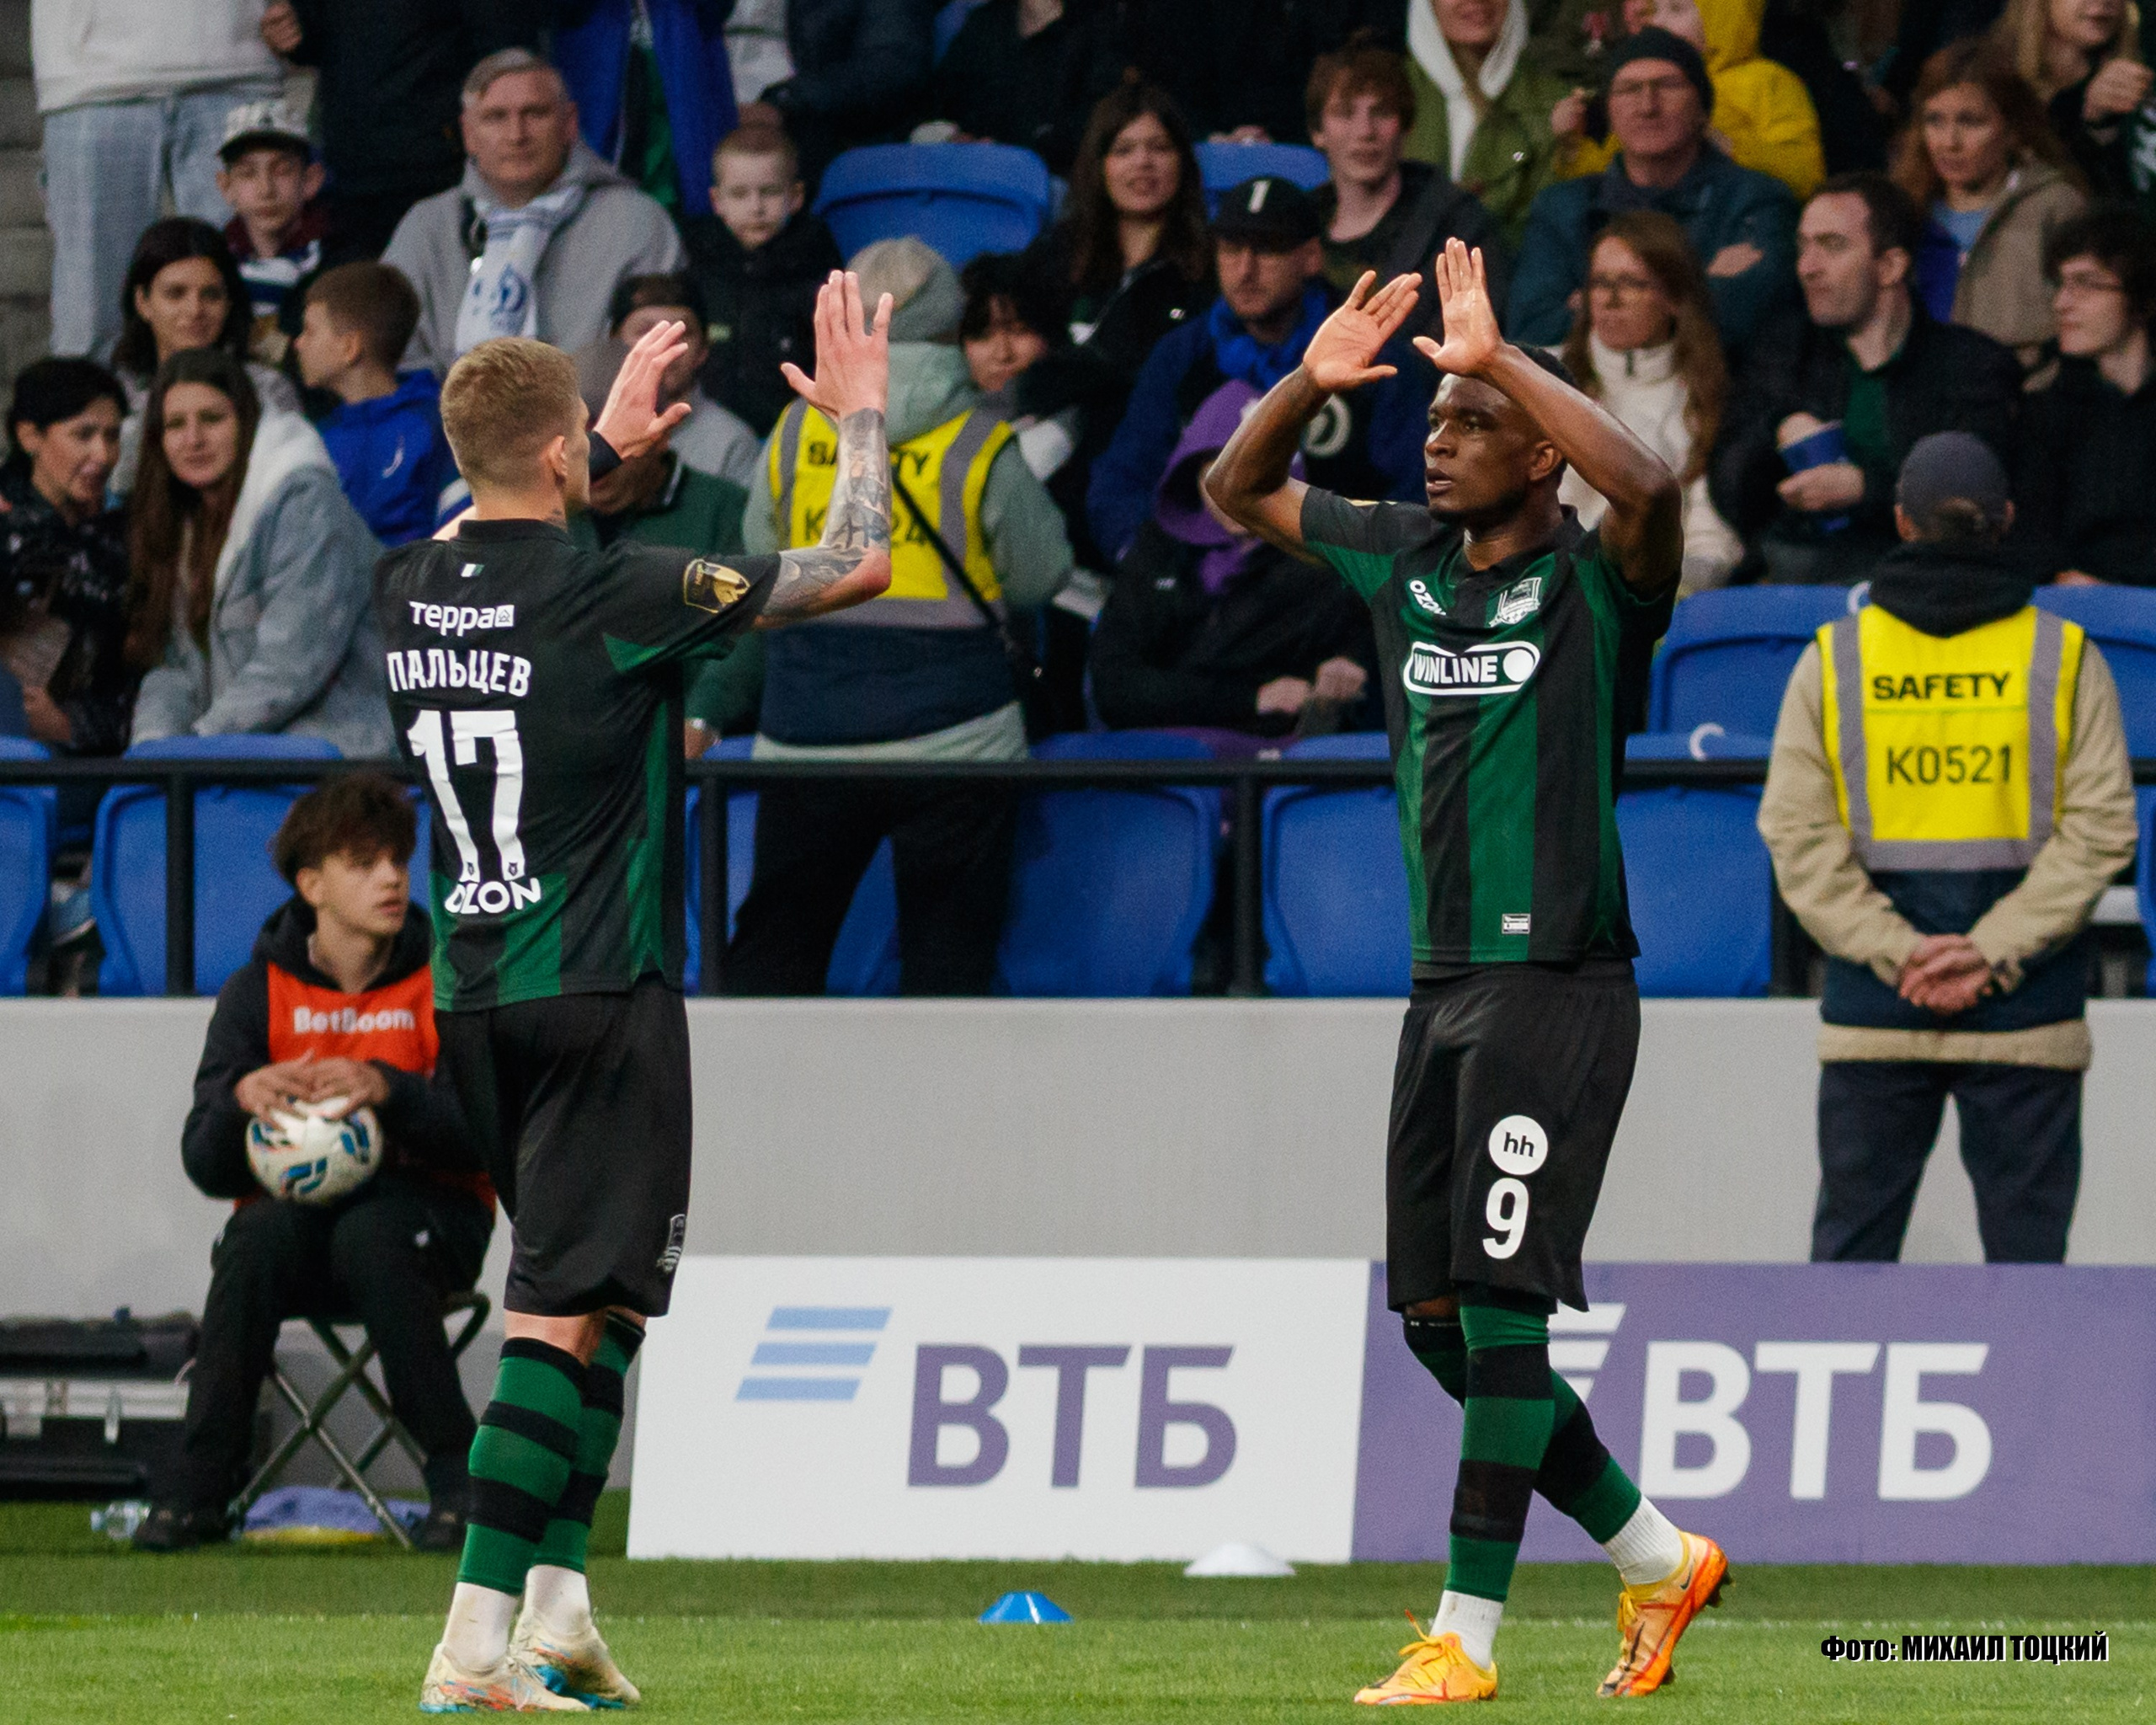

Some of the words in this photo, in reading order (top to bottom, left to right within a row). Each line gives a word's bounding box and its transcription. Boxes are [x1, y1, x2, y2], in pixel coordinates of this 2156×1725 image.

[387, 649, 532, 697] ПАЛЬЦЕВ
[1413, 653, 1499, 685] WINLINE
[1872, 672, 2009, 700] SAFETY
[1887, 744, 2011, 785] K0521
[407, 709, 526, 883] 17
[1503, 1131, 1535, 1158] hh
[1482, 1178, 1529, 1259] 9
[907, 1343, 1238, 1488] ВТБ
[1638, 1341, 1993, 1500] ВТБ
